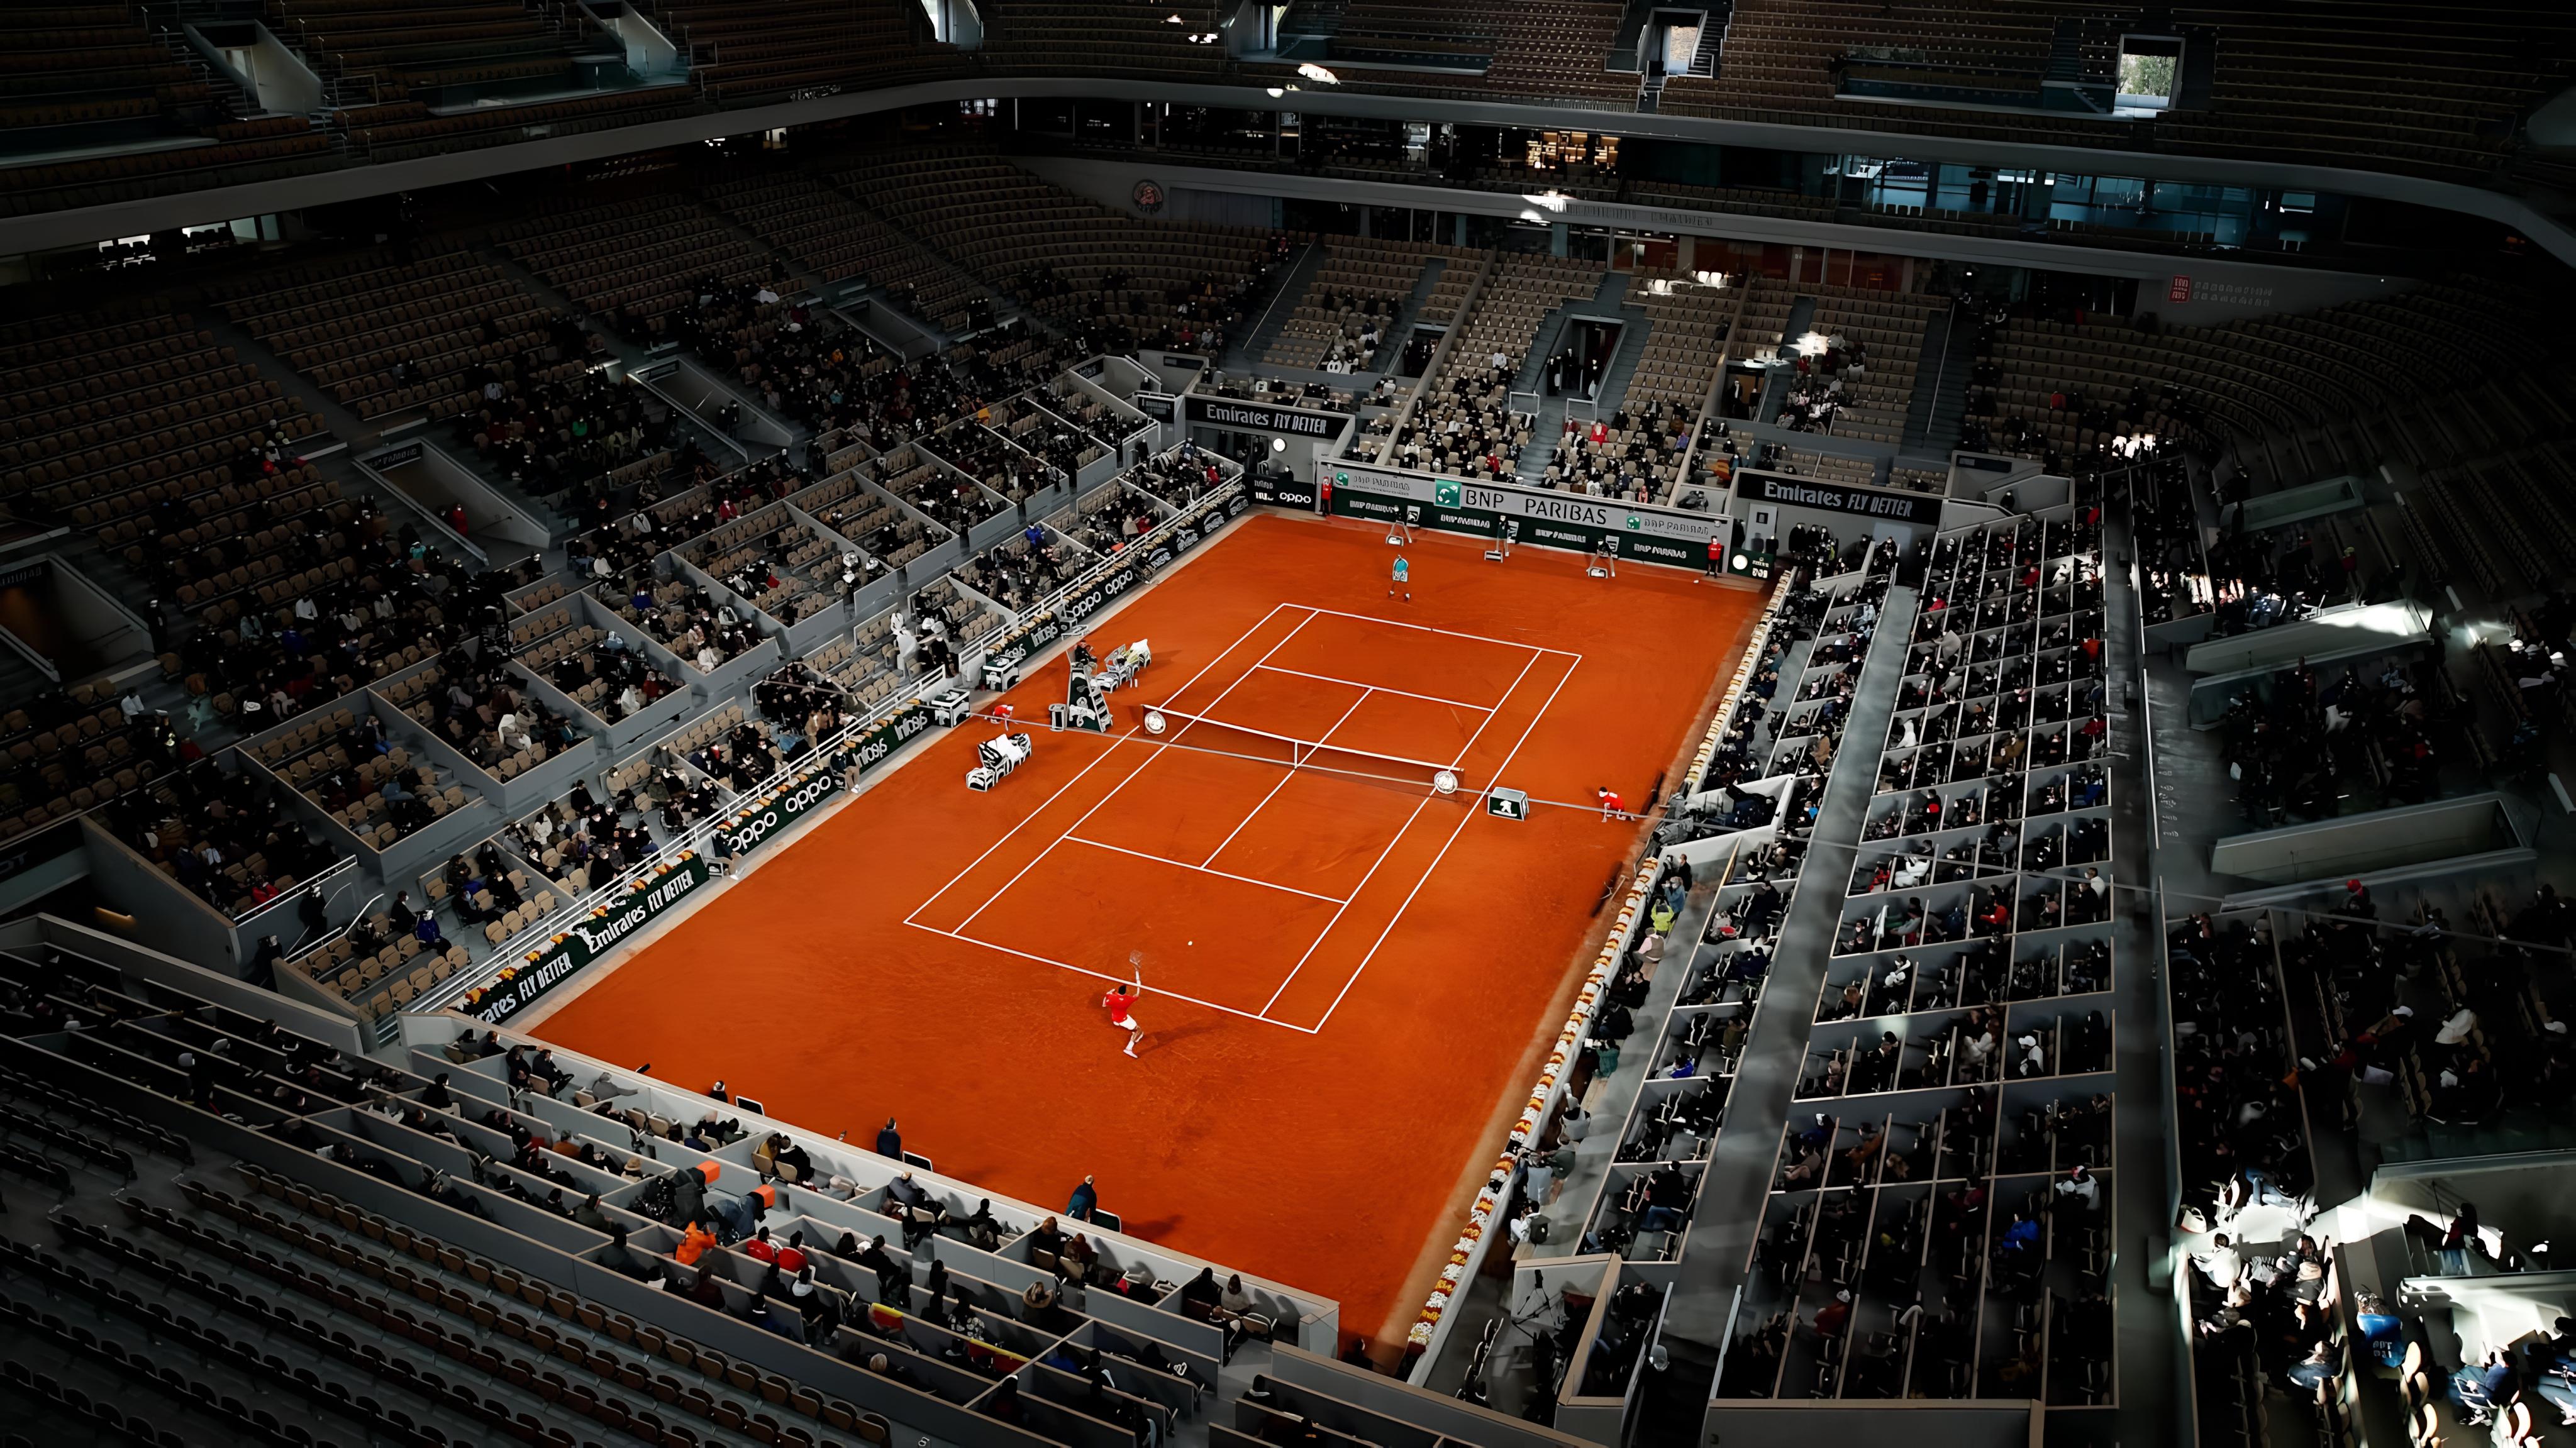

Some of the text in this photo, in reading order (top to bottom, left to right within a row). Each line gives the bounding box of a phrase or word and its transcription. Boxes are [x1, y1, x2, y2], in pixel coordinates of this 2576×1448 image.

[1206, 404, 1269, 426] Emirates
[1279, 492, 1311, 504] oppo
[1465, 489, 1606, 525] BNP PARIBAS
[1764, 480, 1842, 506] Emirates
[1847, 494, 1870, 510] FLY
[1105, 570, 1133, 595] oppo
[1072, 591, 1101, 617] oppo
[785, 775, 831, 812] oppo
[728, 811, 777, 851] oppo
[589, 905, 646, 954] Emirates
[647, 889, 663, 912] FLY
[518, 975, 536, 1001] FLY
